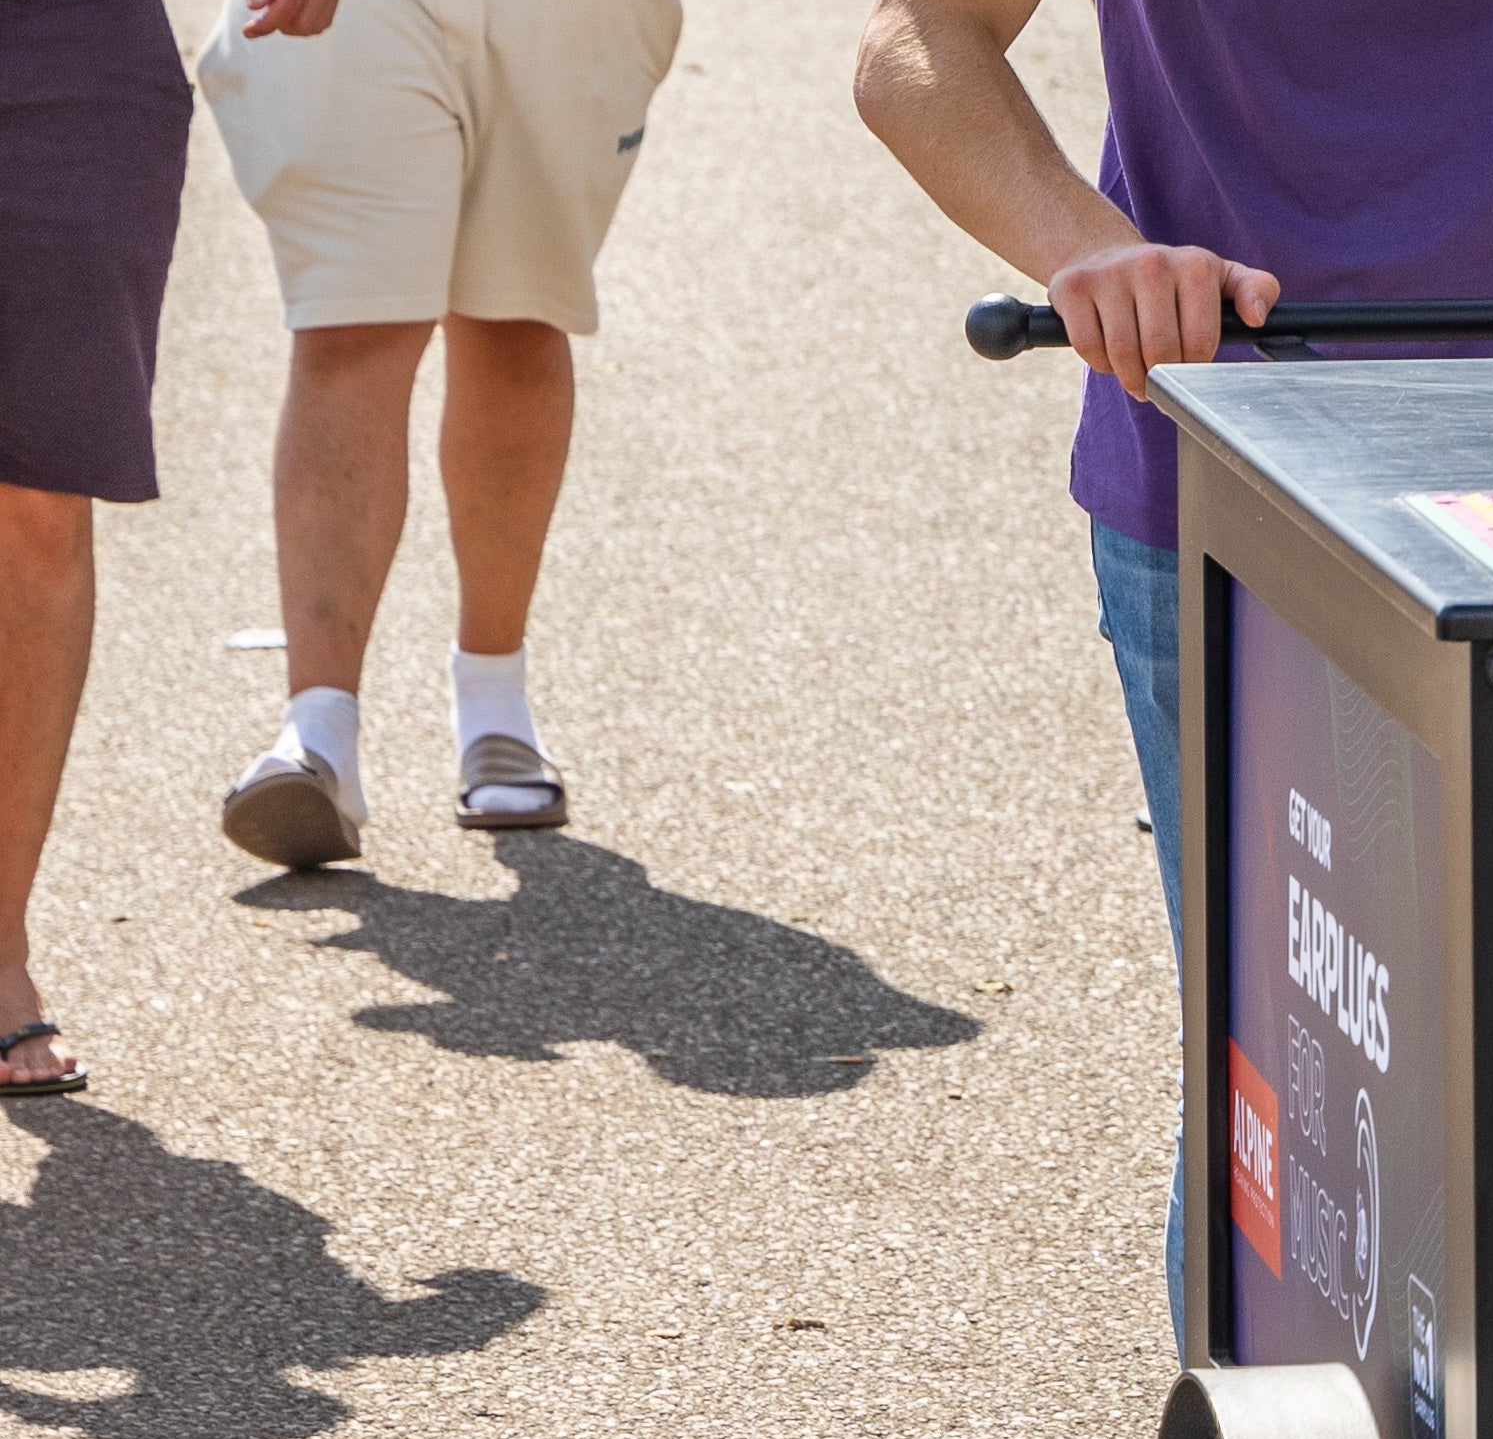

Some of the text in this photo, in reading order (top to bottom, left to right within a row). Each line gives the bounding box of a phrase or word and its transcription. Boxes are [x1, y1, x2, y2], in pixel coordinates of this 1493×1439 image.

[1289, 787, 1331, 872] GET YOUR
[1289, 874, 1390, 1074] EARPLUGS
[1233, 1089, 1274, 1201] ALPINE
[1288, 1014, 1327, 1157] FOR
[1289, 1154, 1350, 1321] MUSIC
